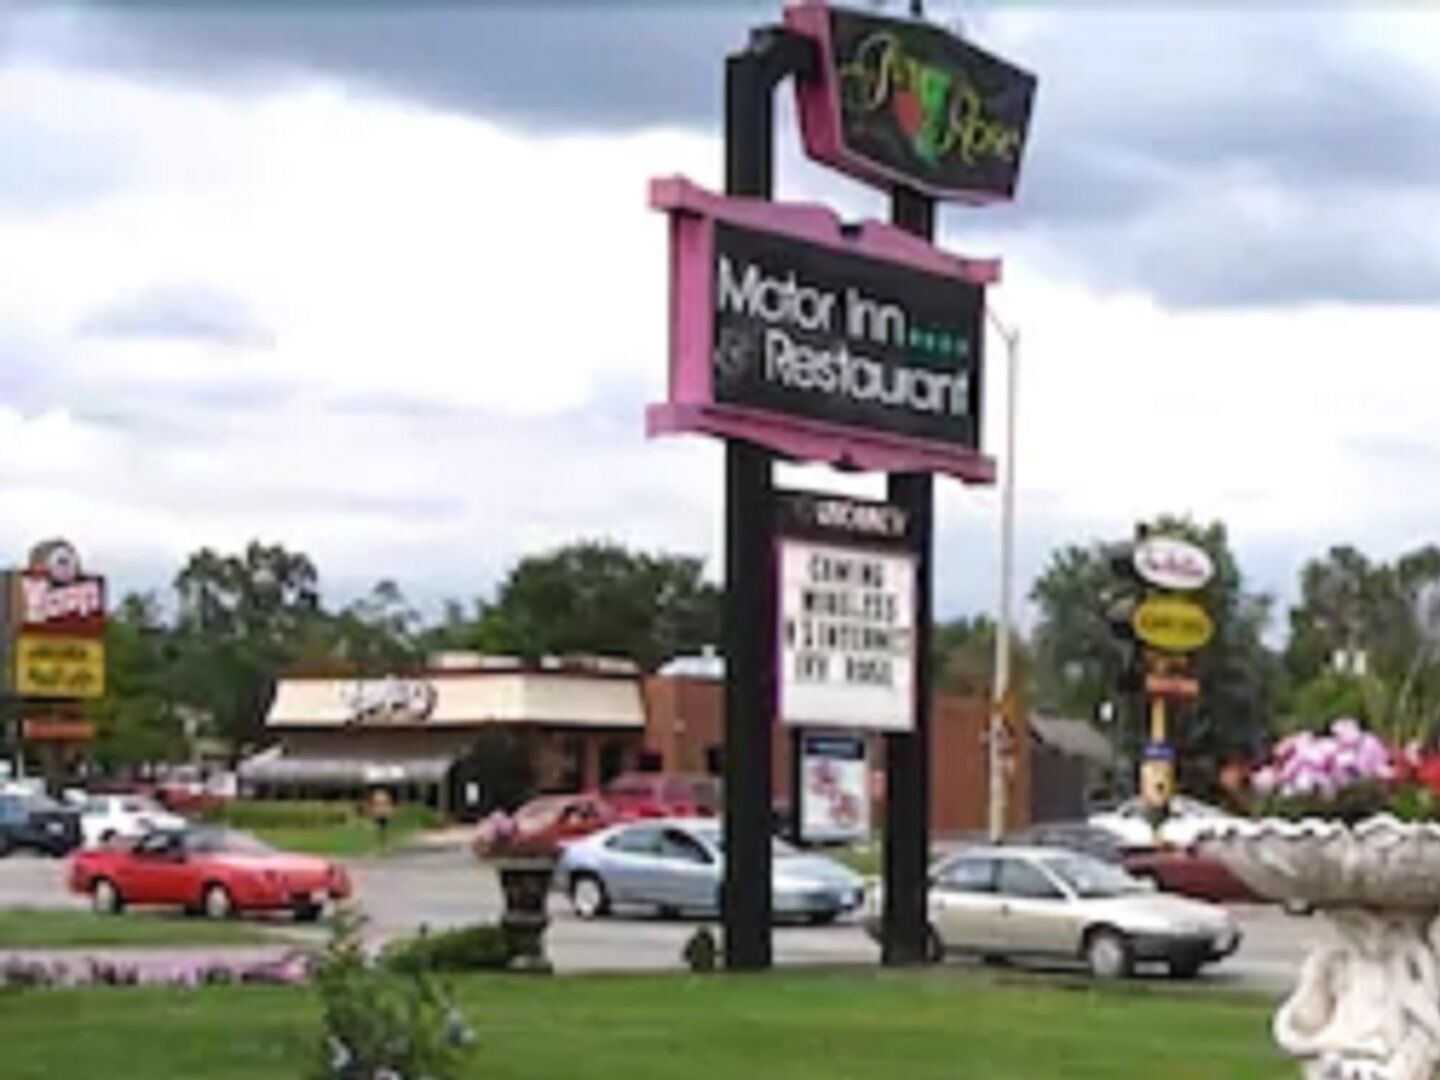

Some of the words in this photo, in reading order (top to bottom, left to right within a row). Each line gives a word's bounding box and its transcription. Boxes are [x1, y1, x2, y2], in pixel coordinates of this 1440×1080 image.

[718, 254, 836, 331] Motor
[846, 286, 906, 348] Inn
[765, 329, 968, 415] Restaurant
